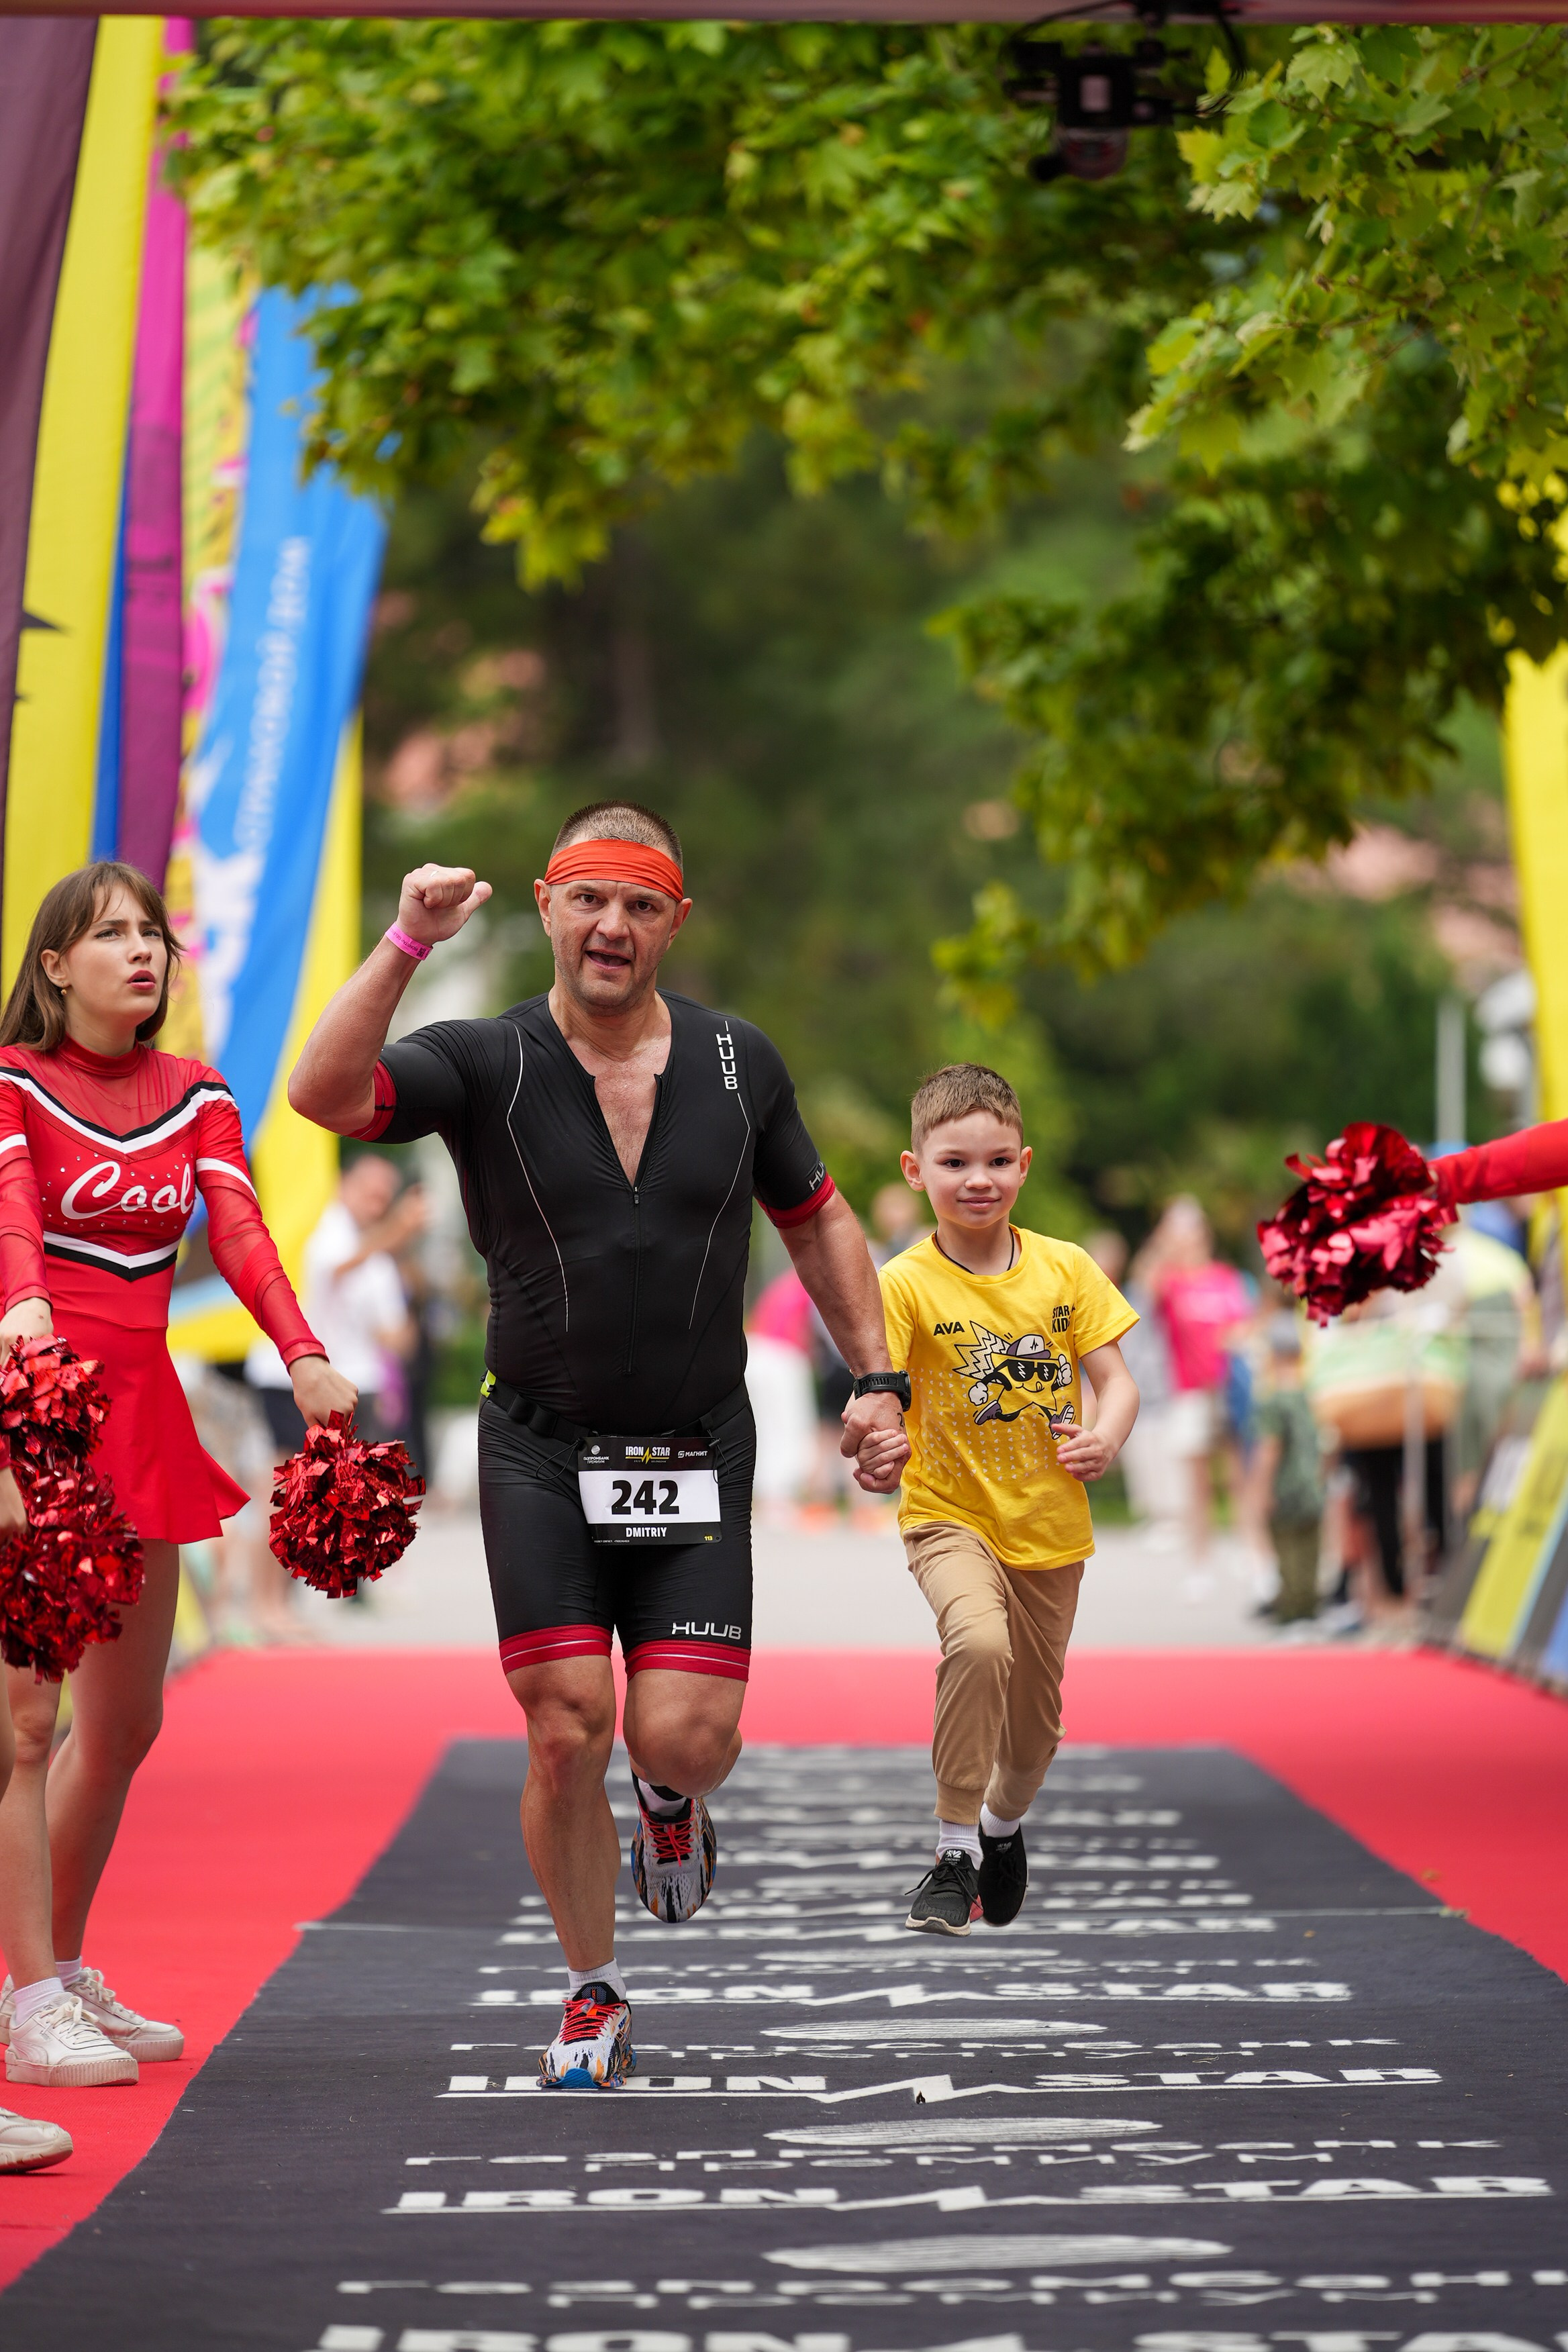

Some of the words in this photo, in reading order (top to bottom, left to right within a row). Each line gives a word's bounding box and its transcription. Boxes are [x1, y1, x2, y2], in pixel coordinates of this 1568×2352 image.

[716, 1033, 738, 1091] HUUB
[60, 1161, 194, 1220] Cool
[1052, 1305, 1070, 1318] STAR
[933, 1321, 965, 1336] AVA
[626, 1447, 644, 1455] IRON
[652, 1447, 671, 1456] STAR
[611, 1479, 680, 1515] 242
[626, 1527, 667, 1538] DMITRIY
[671, 1622, 742, 1640] HUUB
[995, 1981, 1352, 1998] STAR
[1034, 2068, 1443, 2087] STAR
[397, 2188, 840, 2209] IRON
[1079, 2176, 1552, 2200] STAR
[317, 2324, 850, 2352] IRON
